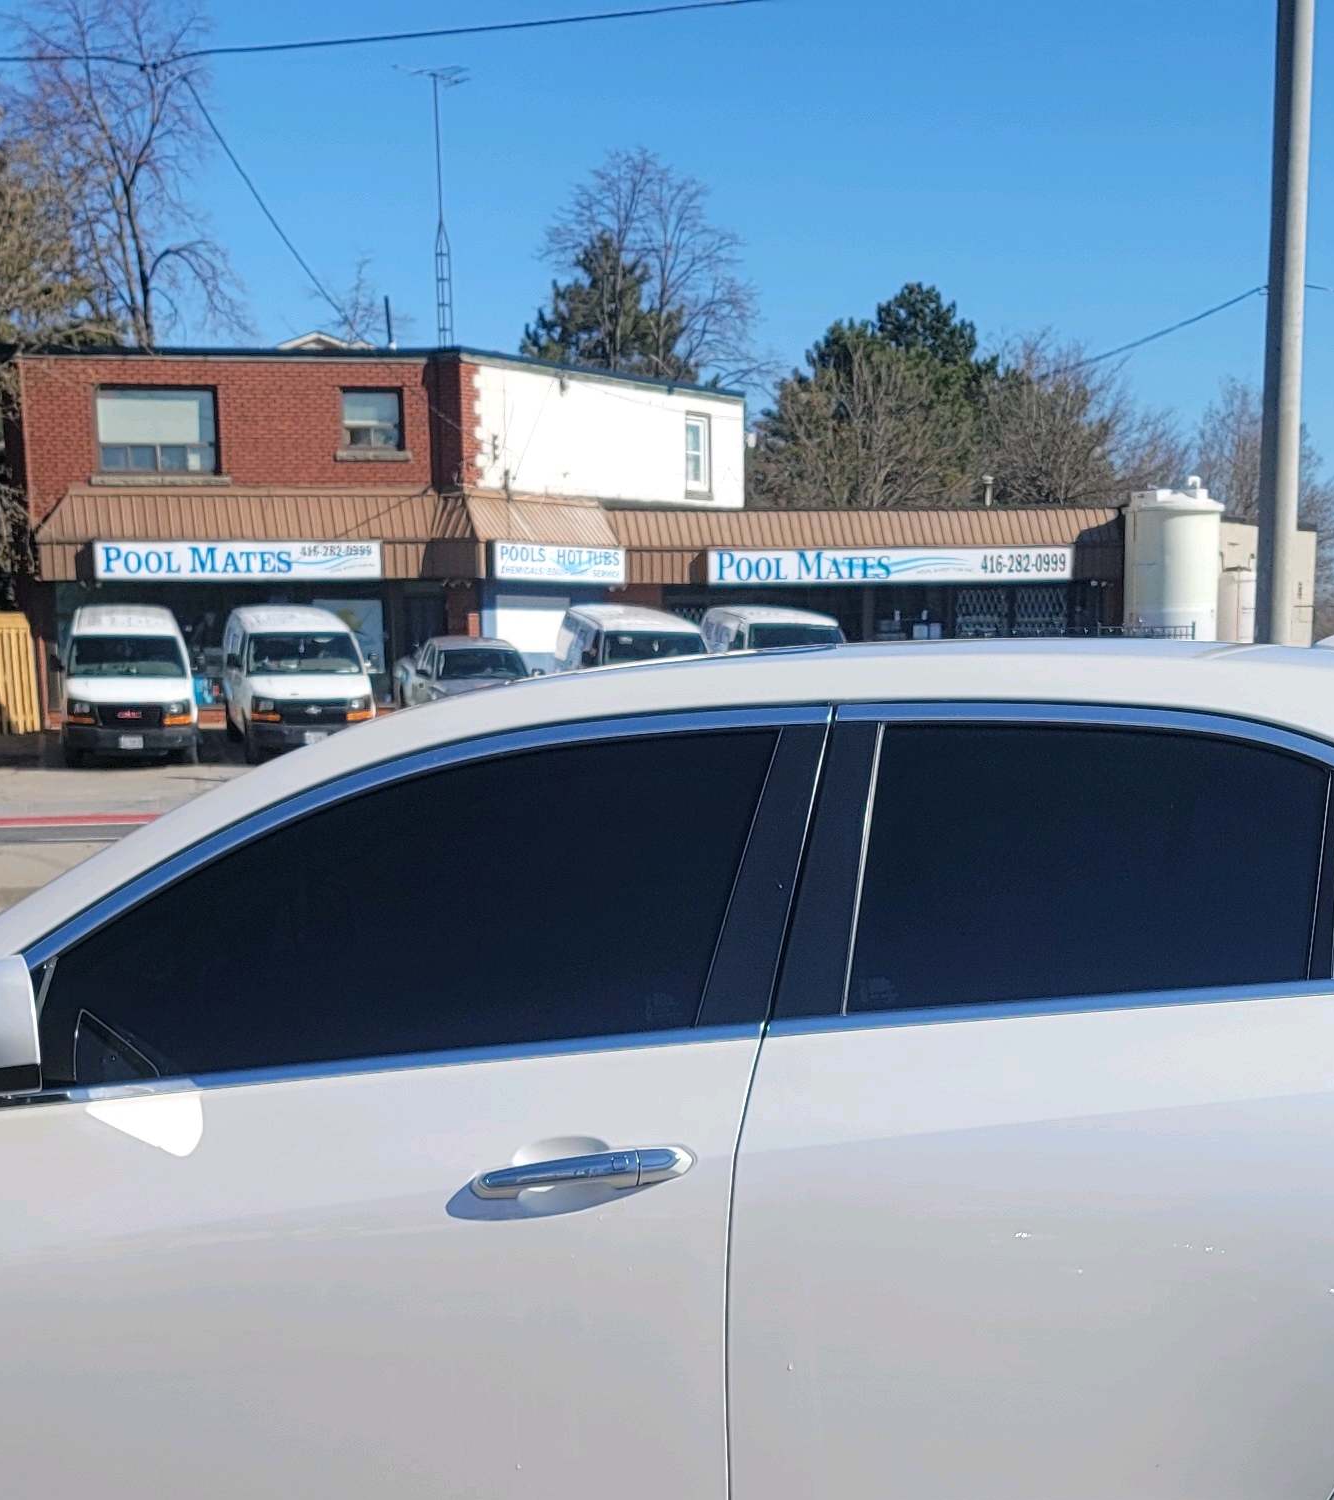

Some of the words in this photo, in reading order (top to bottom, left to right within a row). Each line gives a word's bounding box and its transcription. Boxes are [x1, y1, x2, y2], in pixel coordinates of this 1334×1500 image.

[102, 546, 182, 574] POOL
[188, 546, 293, 574] MATES
[500, 545, 546, 562] POOLS
[556, 549, 583, 566] HOT
[586, 550, 620, 566] TUBS
[717, 551, 788, 581] POOL
[796, 550, 892, 580] MATES
[980, 553, 1066, 574] 416-282-0999
